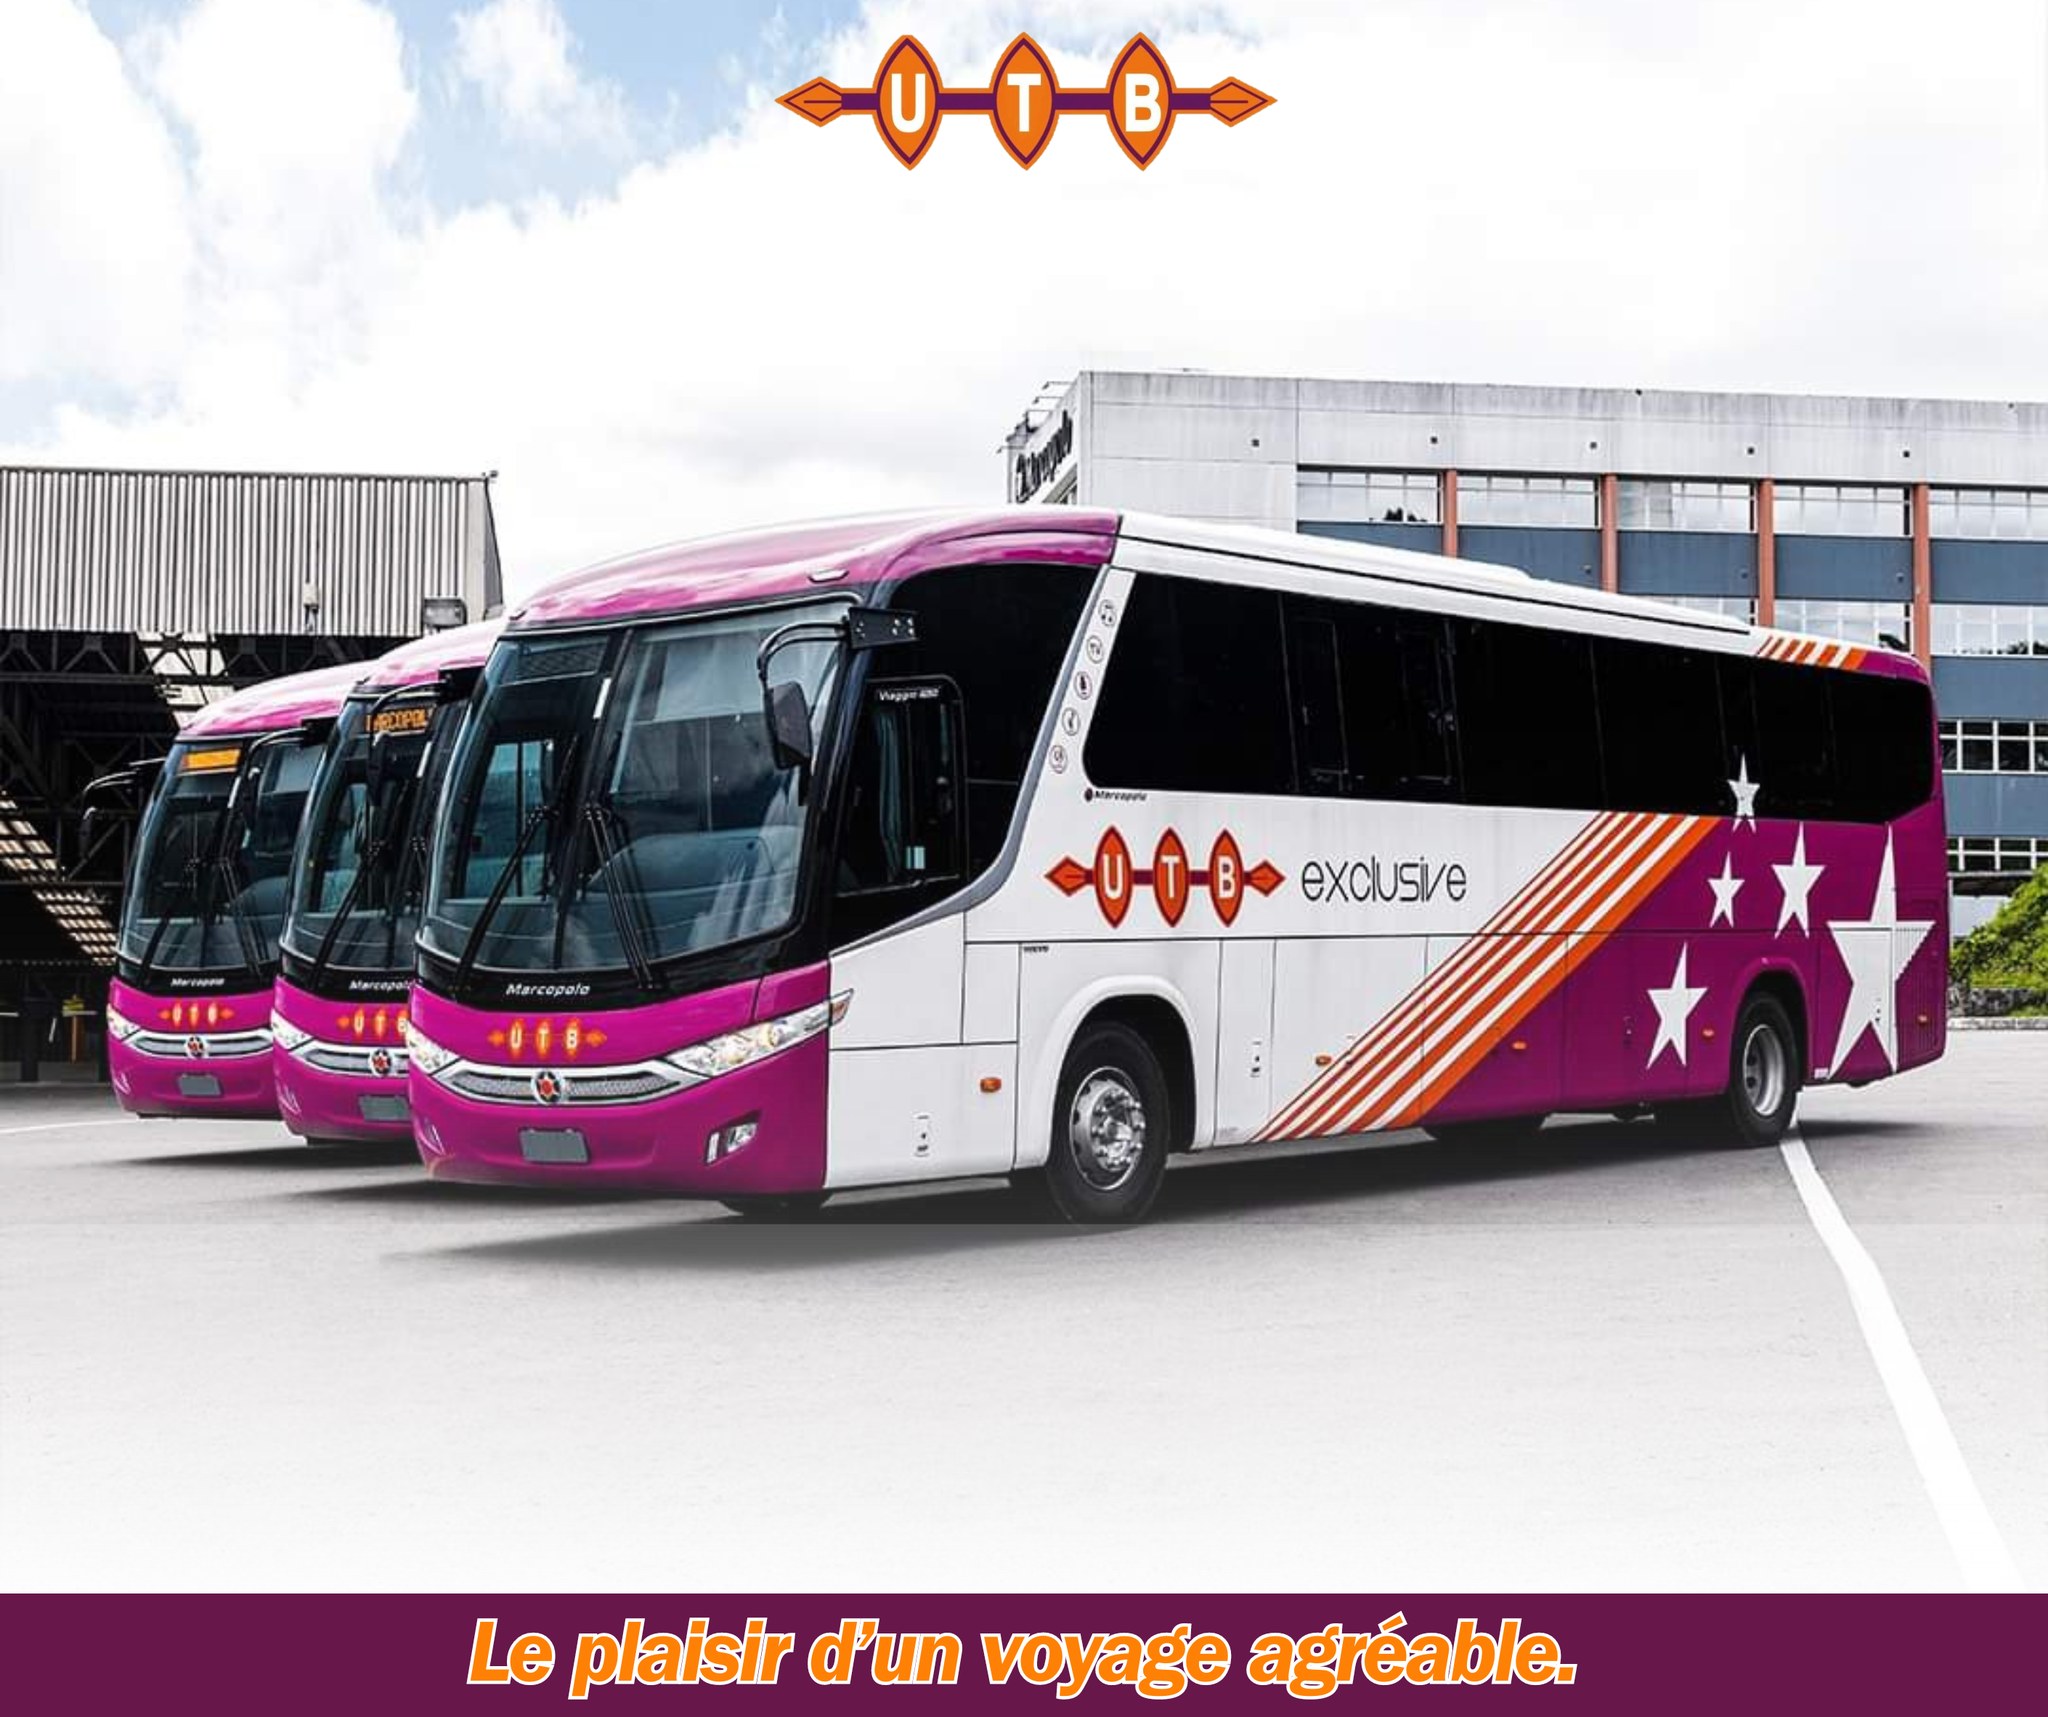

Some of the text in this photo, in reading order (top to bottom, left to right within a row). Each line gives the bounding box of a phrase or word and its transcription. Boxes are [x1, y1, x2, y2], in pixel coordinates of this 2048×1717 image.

[1102, 854, 1466, 902] UTB exclusive
[505, 983, 591, 997] Marcopolo
